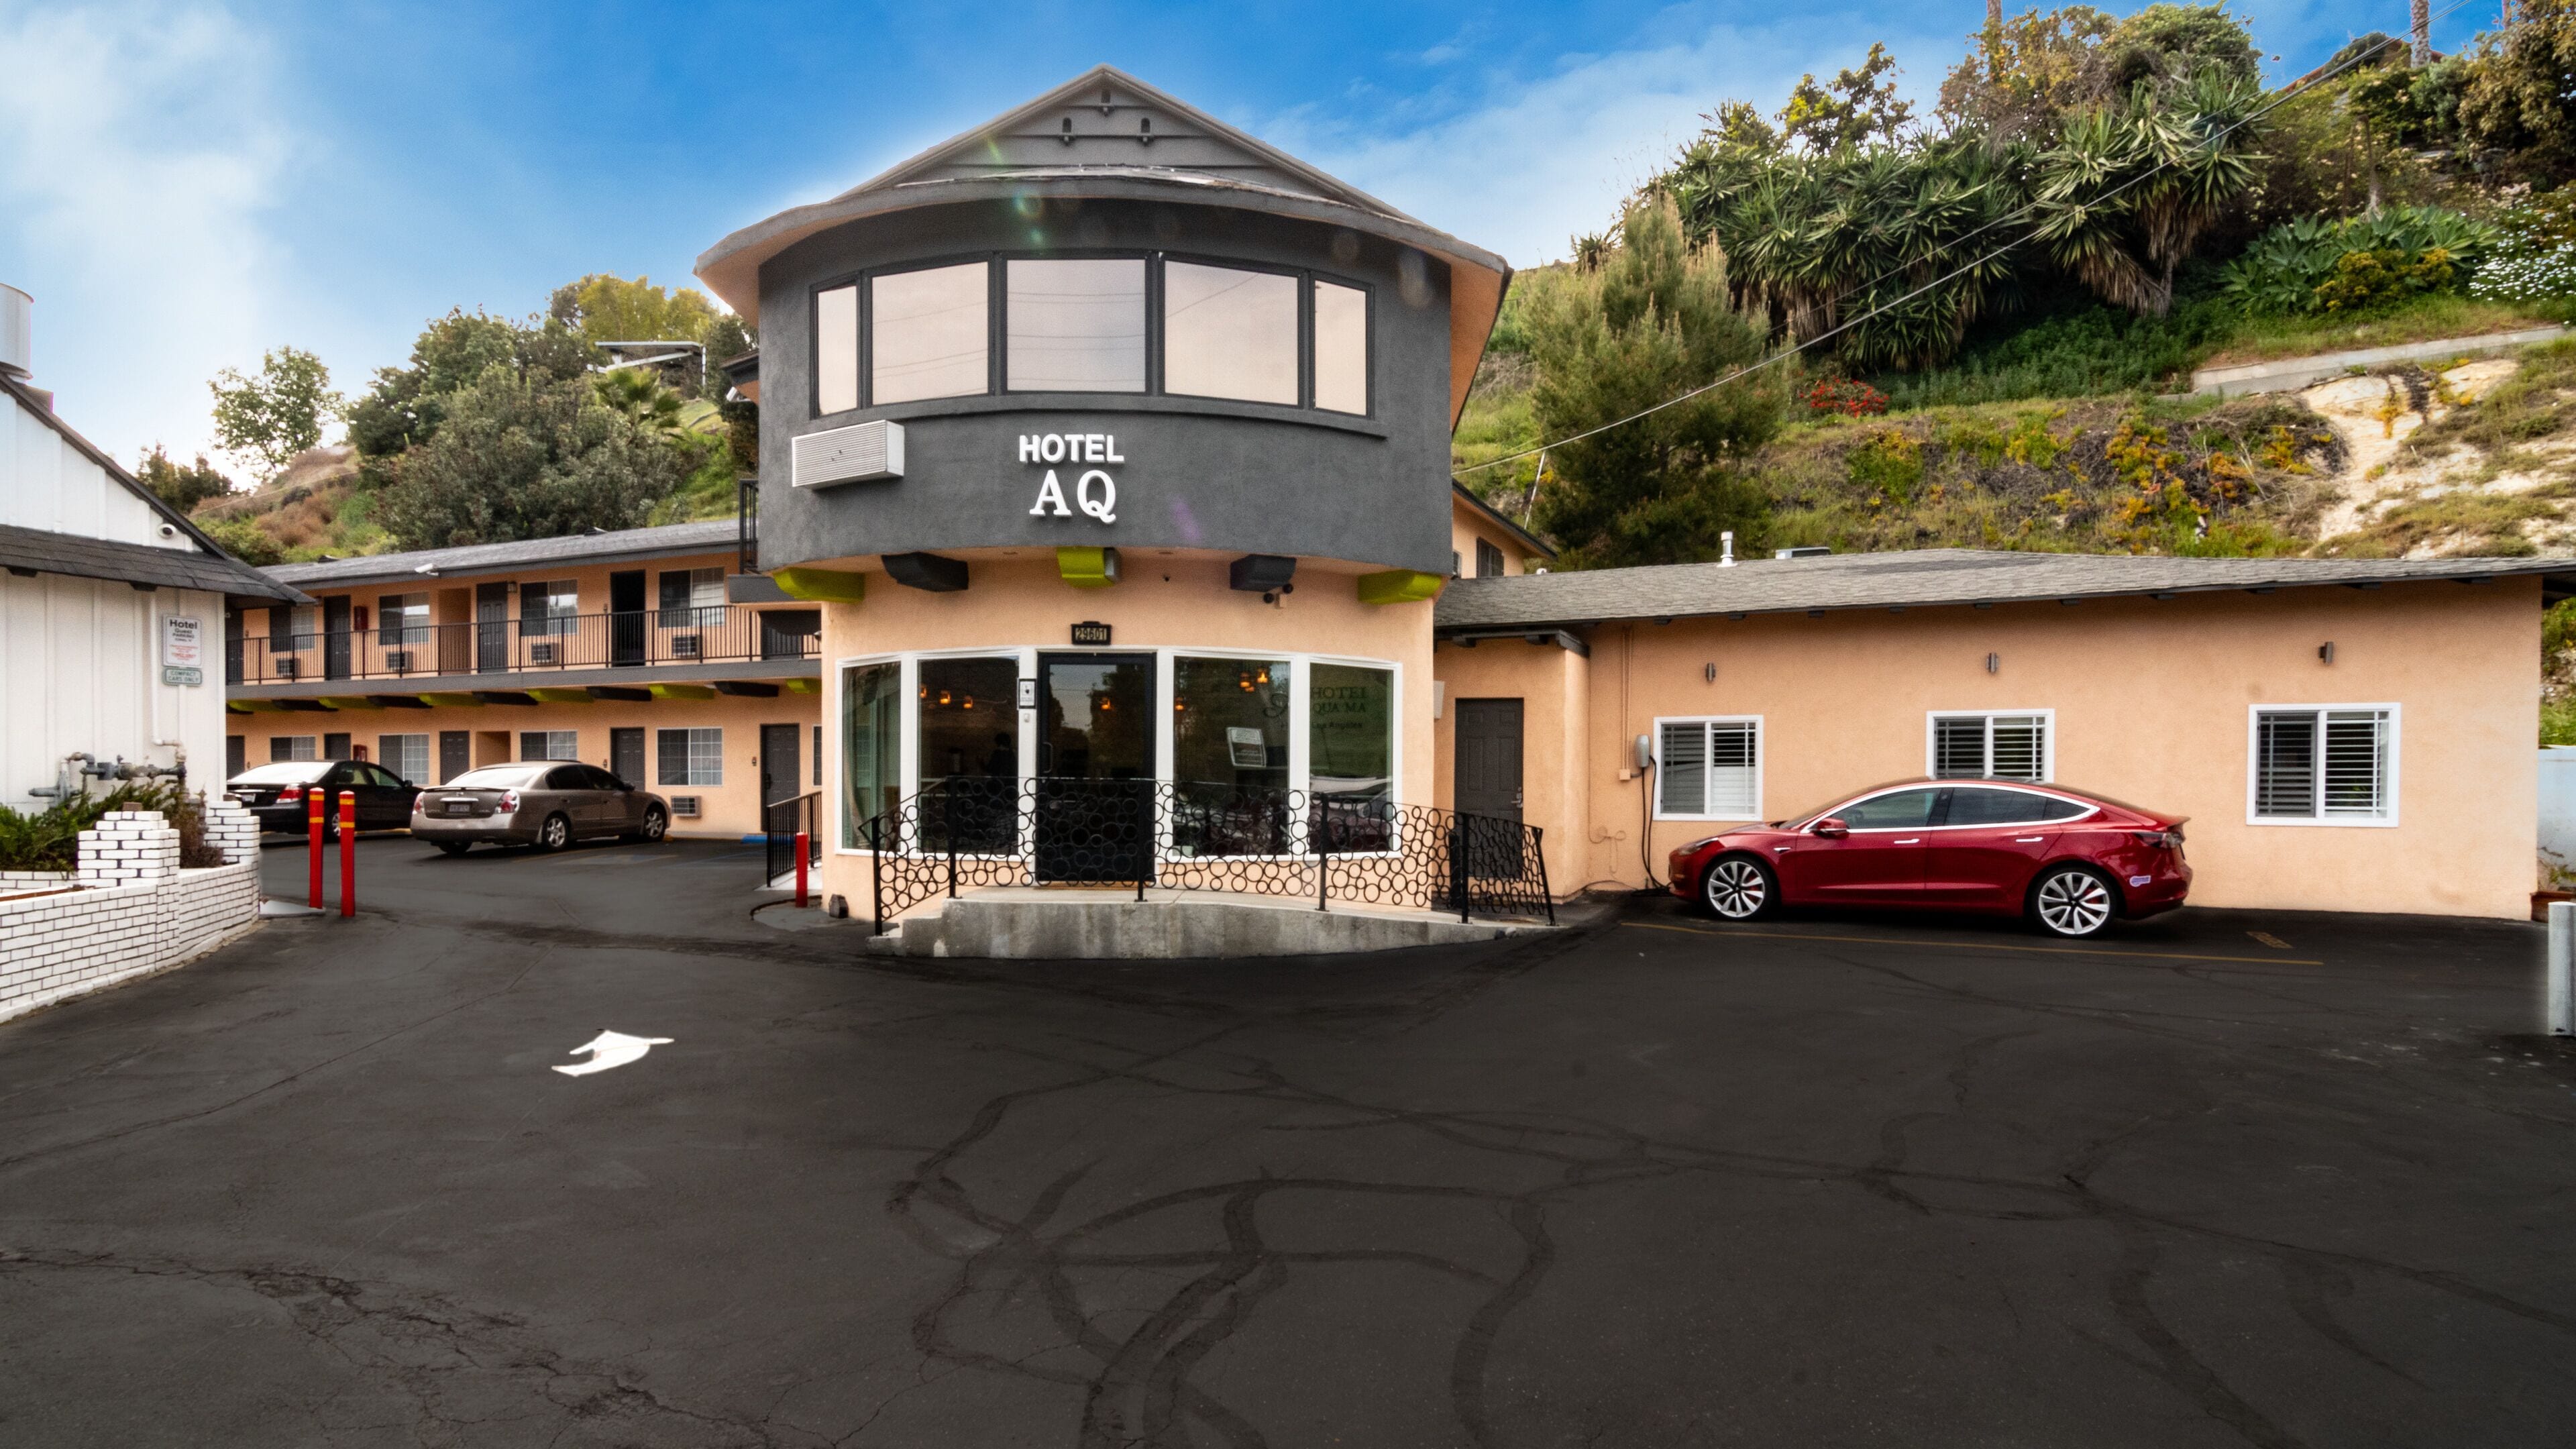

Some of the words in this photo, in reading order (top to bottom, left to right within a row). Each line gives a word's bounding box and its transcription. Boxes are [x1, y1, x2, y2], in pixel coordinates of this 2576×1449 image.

[1019, 433, 1125, 464] HOTEL
[1029, 469, 1116, 525] AQ
[170, 619, 197, 629] Hotel
[1077, 628, 1105, 640] 29601
